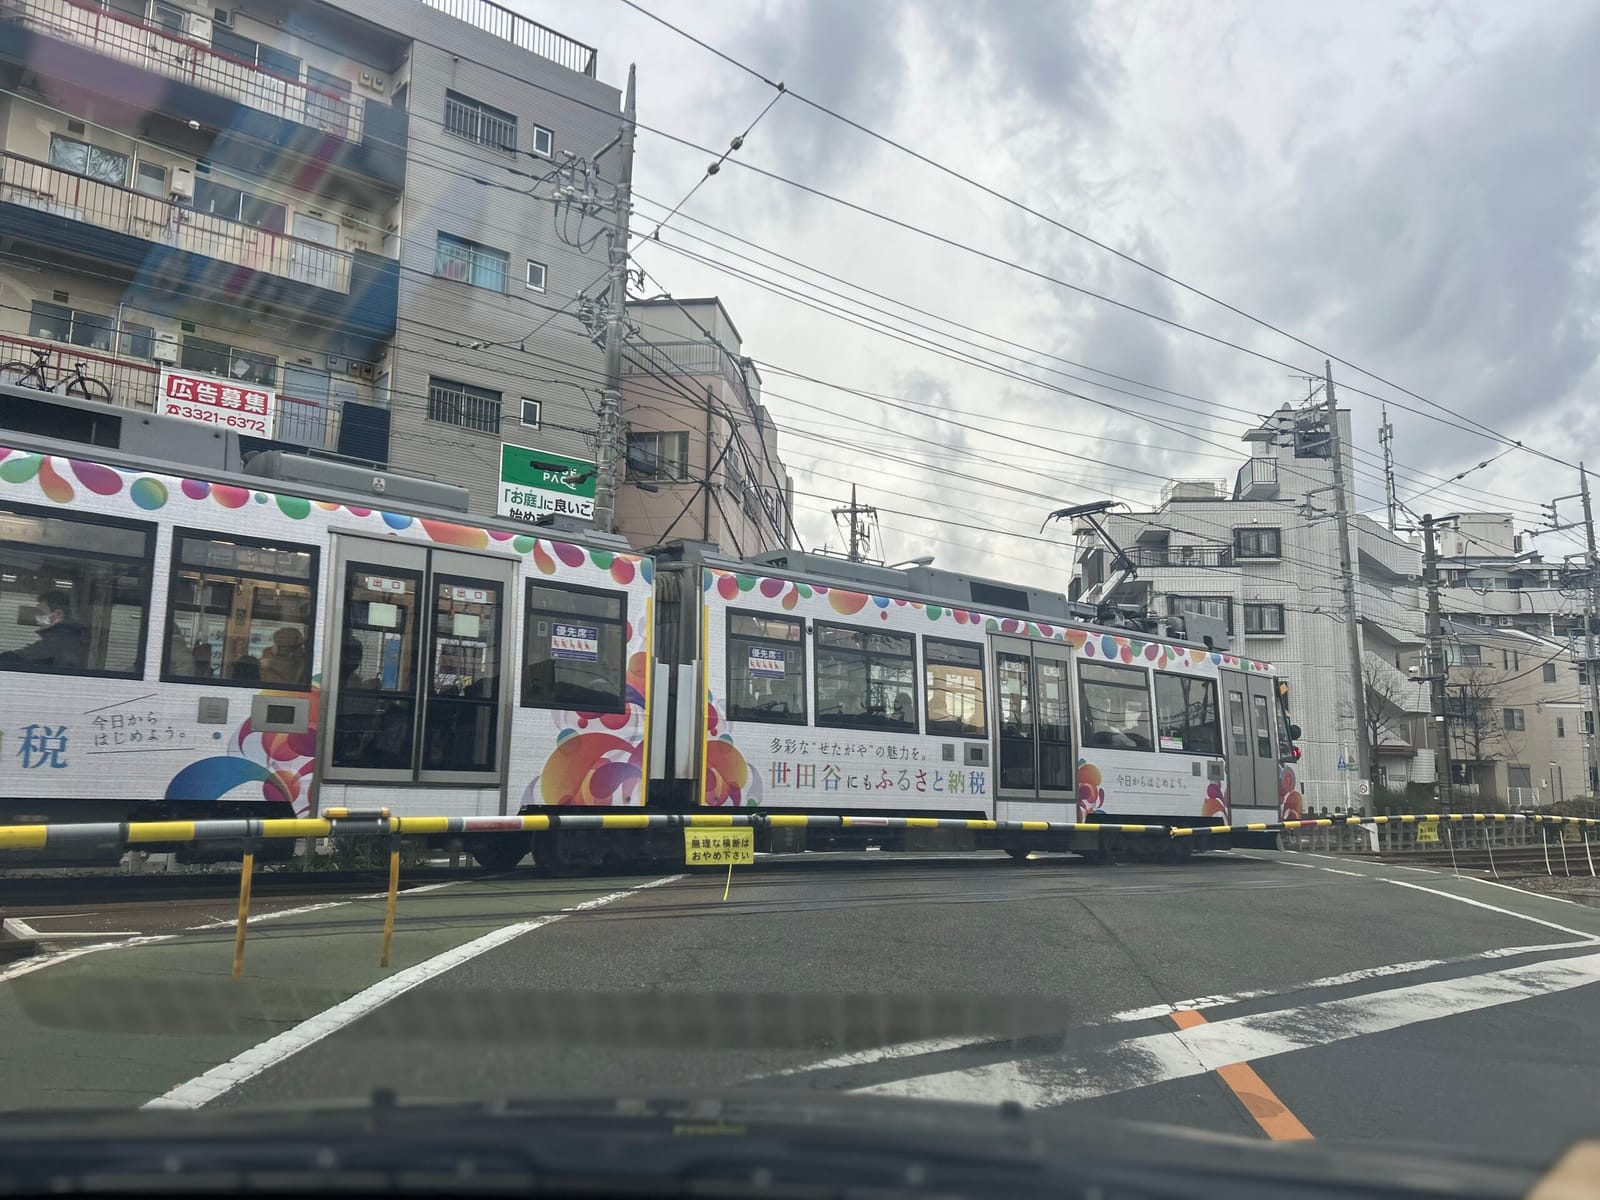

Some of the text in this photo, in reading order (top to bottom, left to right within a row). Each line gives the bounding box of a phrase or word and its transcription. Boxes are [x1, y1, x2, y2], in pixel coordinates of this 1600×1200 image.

[171, 378, 265, 414] 広告募集
[182, 406, 265, 433] 3321-6372
[504, 488, 594, 517] 「お庭」に良いこ
[92, 712, 157, 729] 今日から
[0, 723, 69, 769] 税
[94, 727, 186, 747] はじめよう。
[768, 761, 986, 795] 世田谷にもふるさと納税
[691, 850, 750, 861] おやめ下さい
